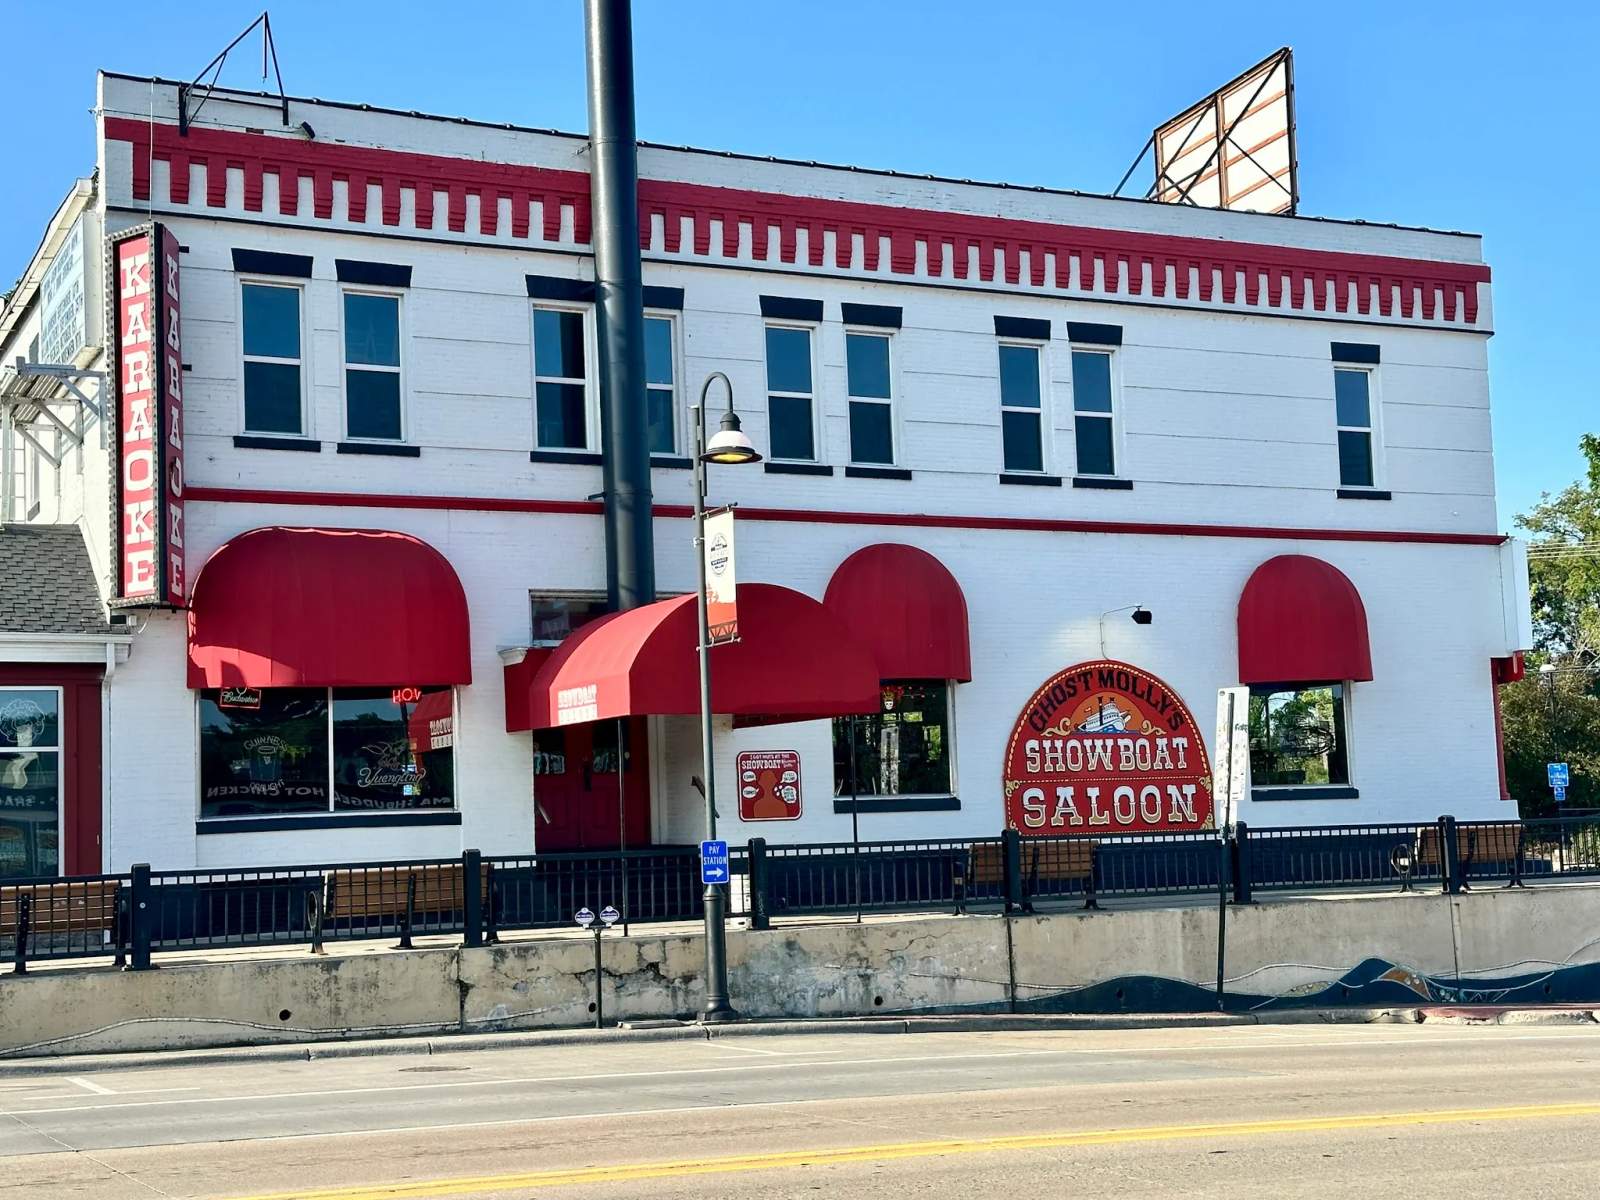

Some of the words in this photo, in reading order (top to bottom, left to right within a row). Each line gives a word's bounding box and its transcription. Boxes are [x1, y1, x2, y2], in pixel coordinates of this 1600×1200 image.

[121, 254, 155, 595] KARAOKE
[165, 253, 184, 597] KARAOKE
[1028, 670, 1093, 732] GHOST
[1097, 669, 1185, 731] MOLLY'S
[243, 735, 288, 752] GUINNESS
[1025, 737, 1189, 773] SHOWBOAT
[357, 767, 427, 787] Yuengling
[741, 760, 781, 769] SHOWBOAT
[1022, 784, 1198, 829] SALOON
[703, 856, 727, 865] STATION
[708, 845, 720, 855] PAY
